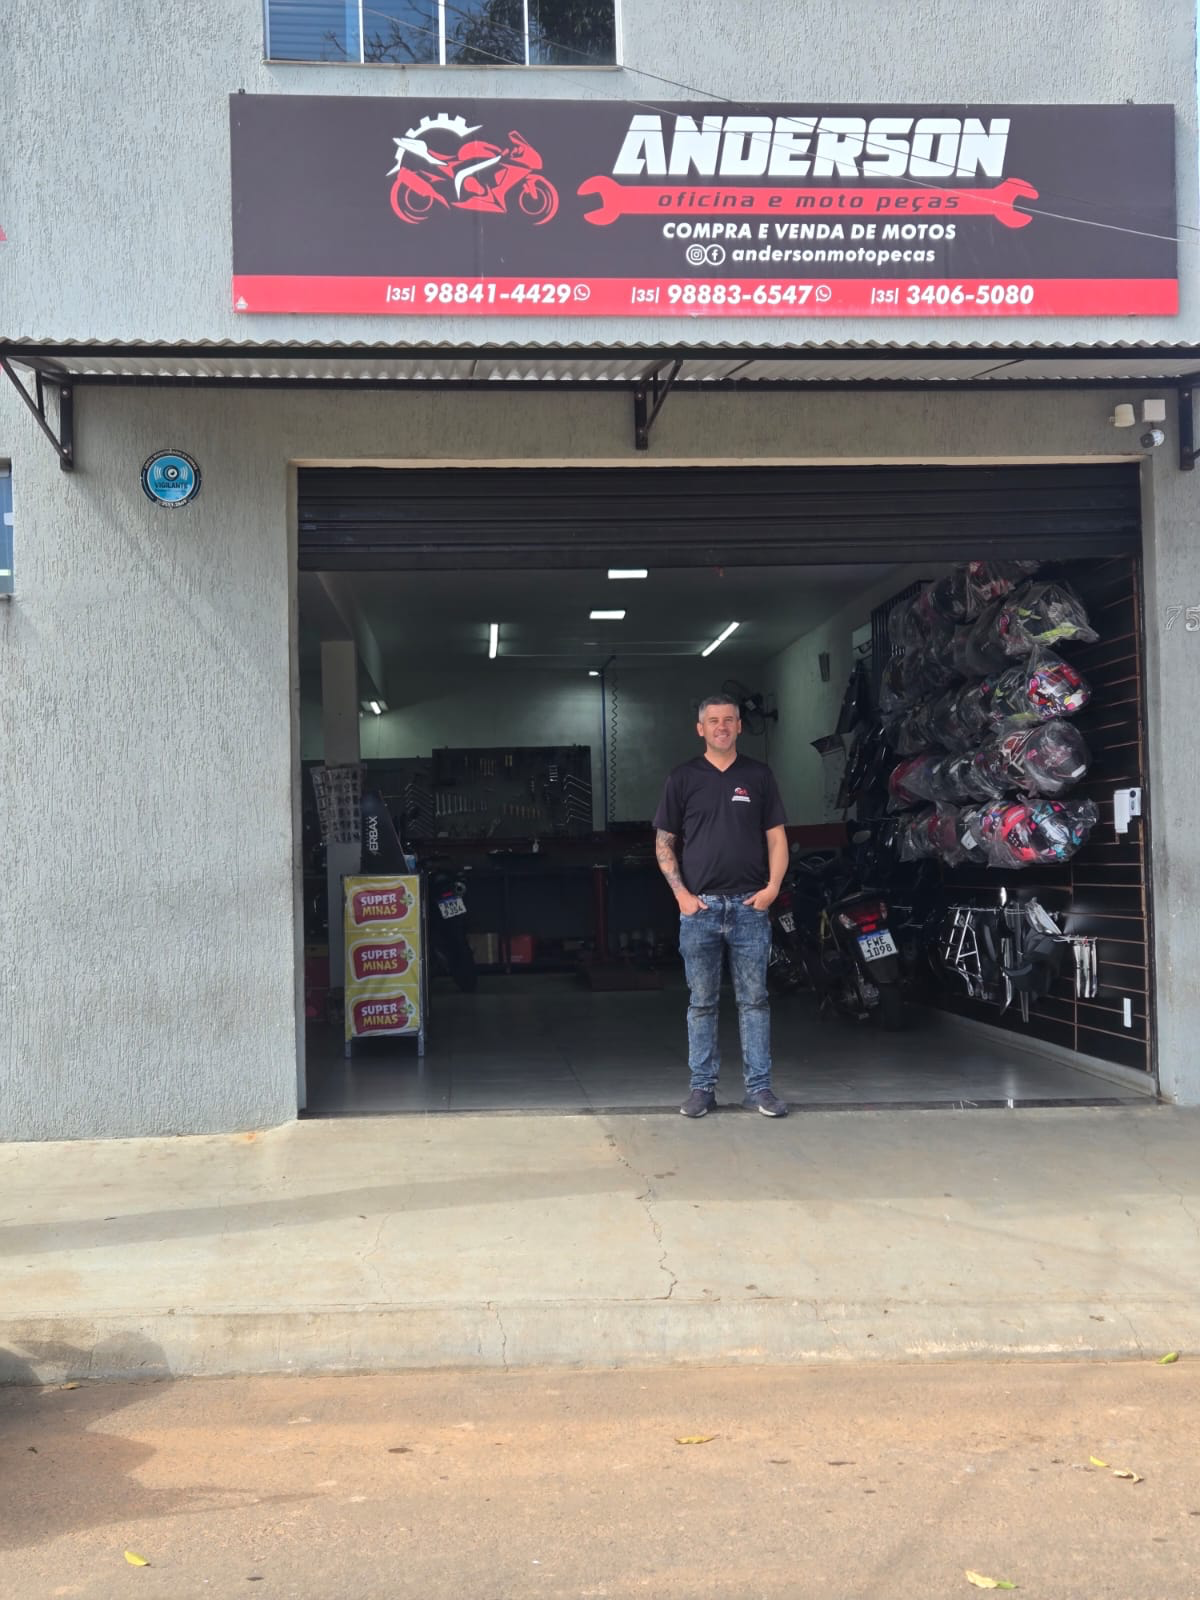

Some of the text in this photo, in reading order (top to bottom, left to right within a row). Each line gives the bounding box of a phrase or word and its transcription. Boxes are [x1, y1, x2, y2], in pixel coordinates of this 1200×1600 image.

[612, 115, 1011, 177] ANDERSON
[658, 192, 960, 213] oficina e moto peças
[662, 222, 957, 240] COMPRA E VENDA DE MOTOS
[731, 244, 936, 266] andersonmotopecas
[424, 283, 572, 304] 98841-4429
[667, 284, 813, 305] 98883-6547
[906, 284, 1035, 305] 3406-5080
[361, 893, 398, 906] SUPER
[362, 904, 398, 917] MINAS
[866, 935, 887, 949] FWE
[361, 948, 398, 961] SUPER
[362, 959, 398, 972] MINAS
[361, 1003, 398, 1016] SUPER
[362, 1014, 398, 1027] MINAS
